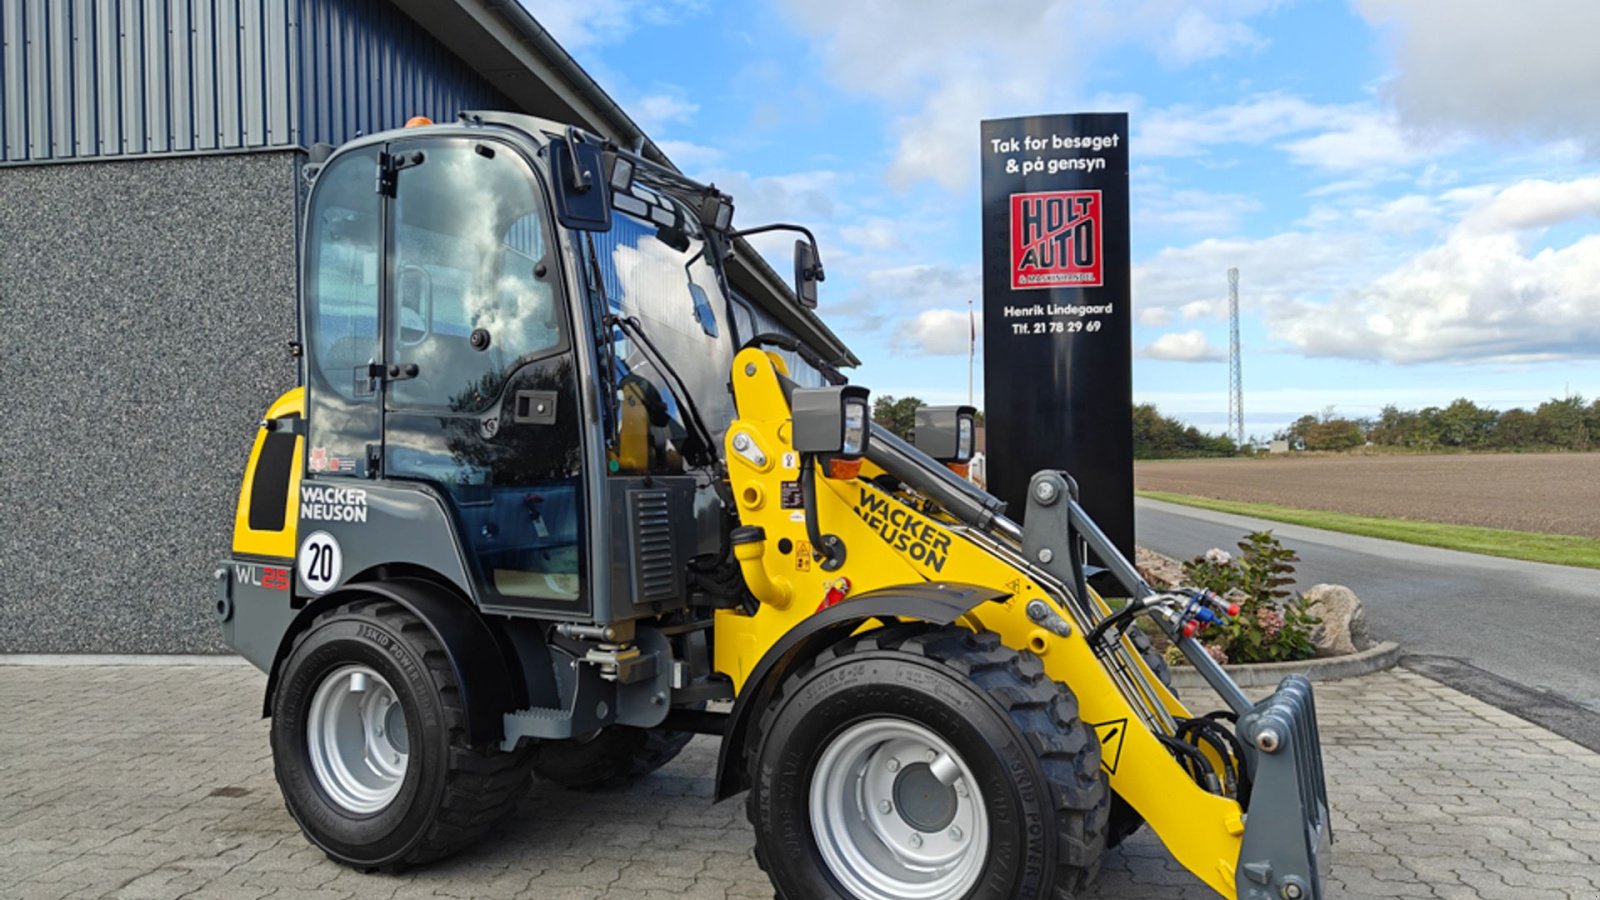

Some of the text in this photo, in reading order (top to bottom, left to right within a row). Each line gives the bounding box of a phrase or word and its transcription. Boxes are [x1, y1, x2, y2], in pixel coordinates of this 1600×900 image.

[991, 133, 1120, 153] Tak for besøget
[1005, 156, 1106, 176] & på gensyn
[1021, 196, 1094, 248] HOLT
[1018, 217, 1096, 270] AUTO
[1004, 302, 1113, 318] Henrik Lindegaard
[1012, 320, 1101, 335] Tlf. 21 78 29 69
[301, 486, 367, 505] WACKER
[301, 504, 367, 522] NEUSON
[858, 487, 952, 555] WACKER
[308, 542, 333, 582] 20
[235, 564, 289, 591] WL25
[365, 627, 421, 681] SKID POWER
[1026, 812, 1043, 877] POWER
